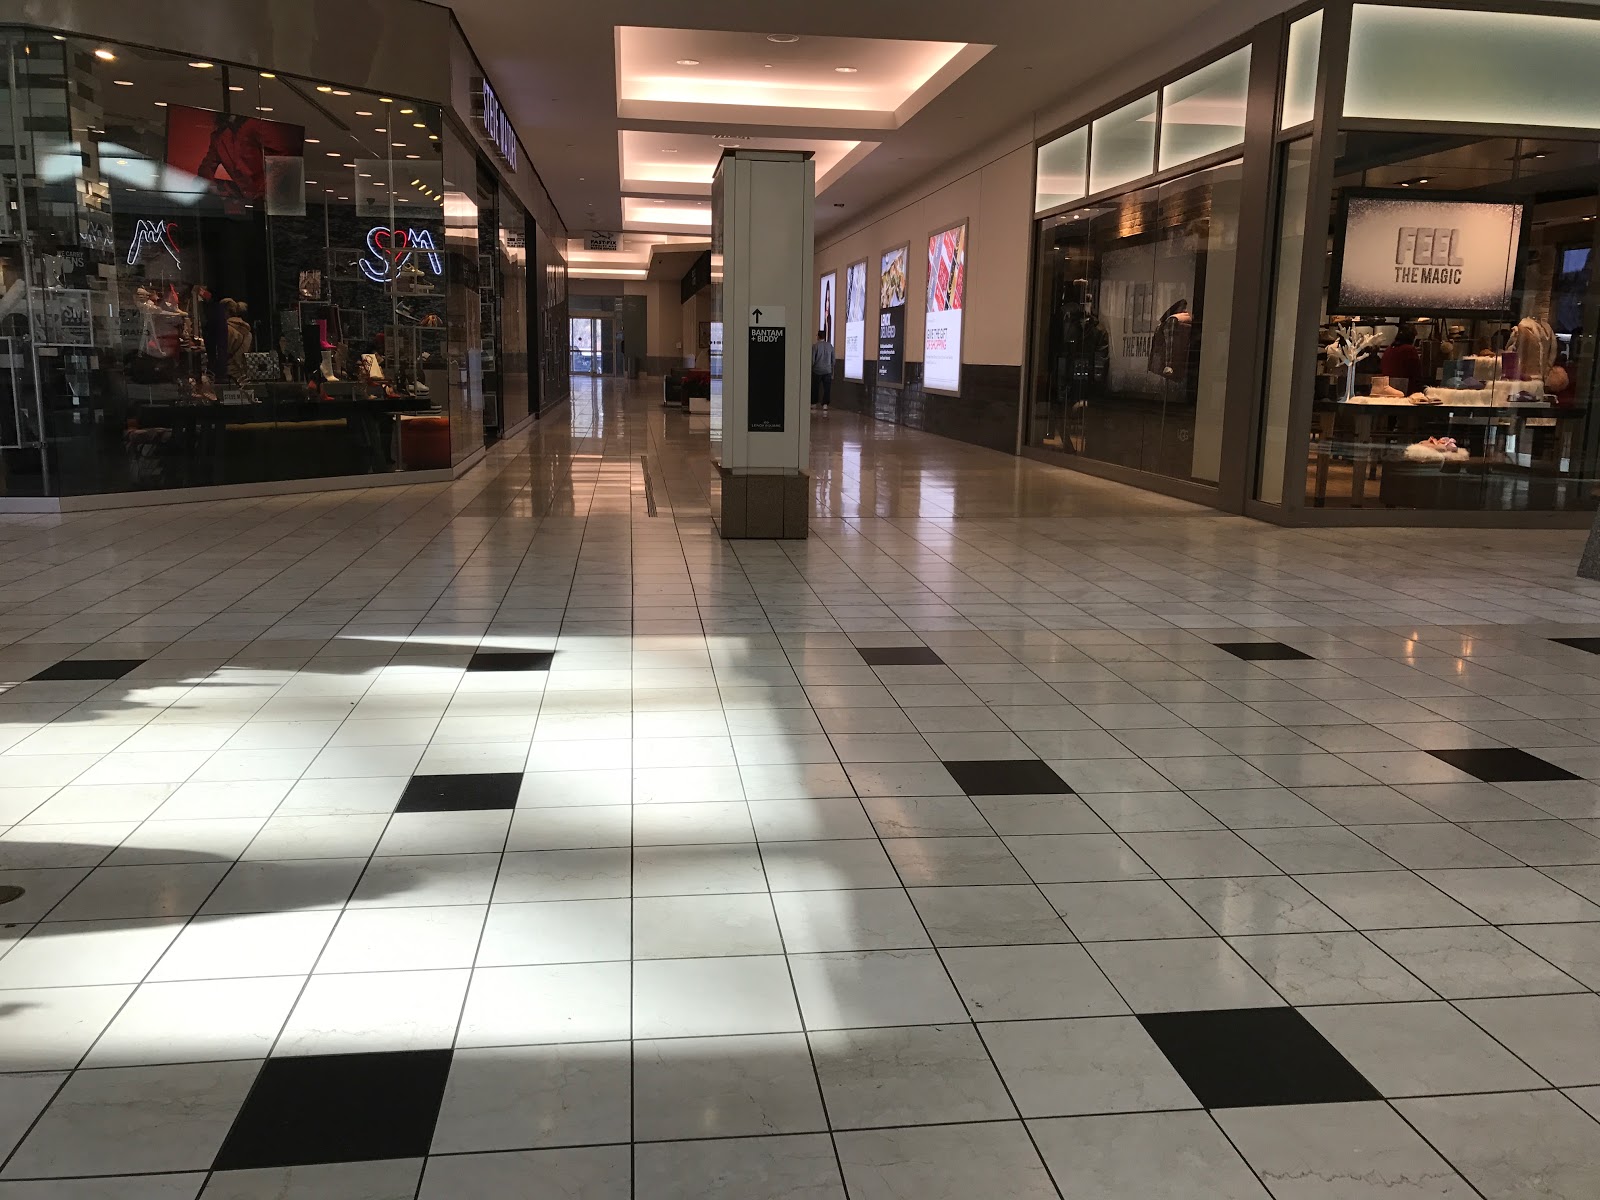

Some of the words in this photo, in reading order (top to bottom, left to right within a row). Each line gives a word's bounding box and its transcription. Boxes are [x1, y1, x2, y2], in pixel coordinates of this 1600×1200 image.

[1395, 226, 1464, 267] FEEL
[1394, 267, 1418, 284] THE
[1420, 267, 1463, 285] MAGIC
[757, 335, 779, 343] BIDDY
